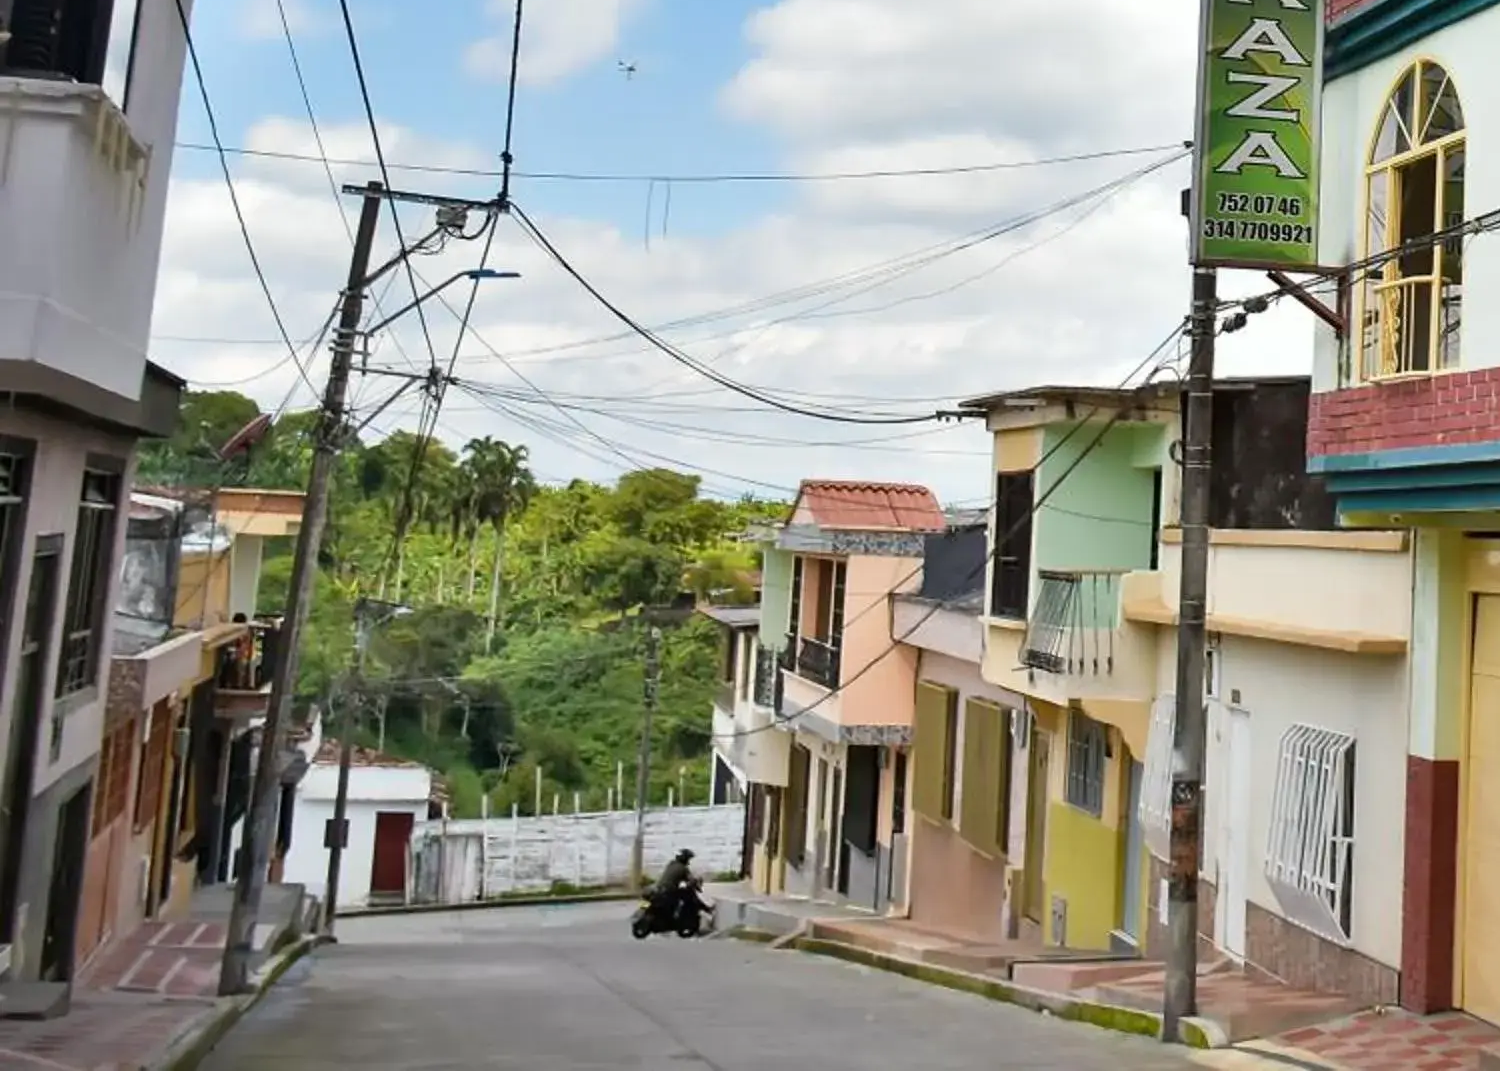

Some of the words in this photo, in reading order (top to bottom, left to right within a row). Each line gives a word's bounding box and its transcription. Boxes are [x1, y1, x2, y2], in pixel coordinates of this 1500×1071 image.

[1217, 192, 1250, 213] 752
[1203, 218, 1236, 239] 314
[1239, 220, 1314, 245] 7709921
